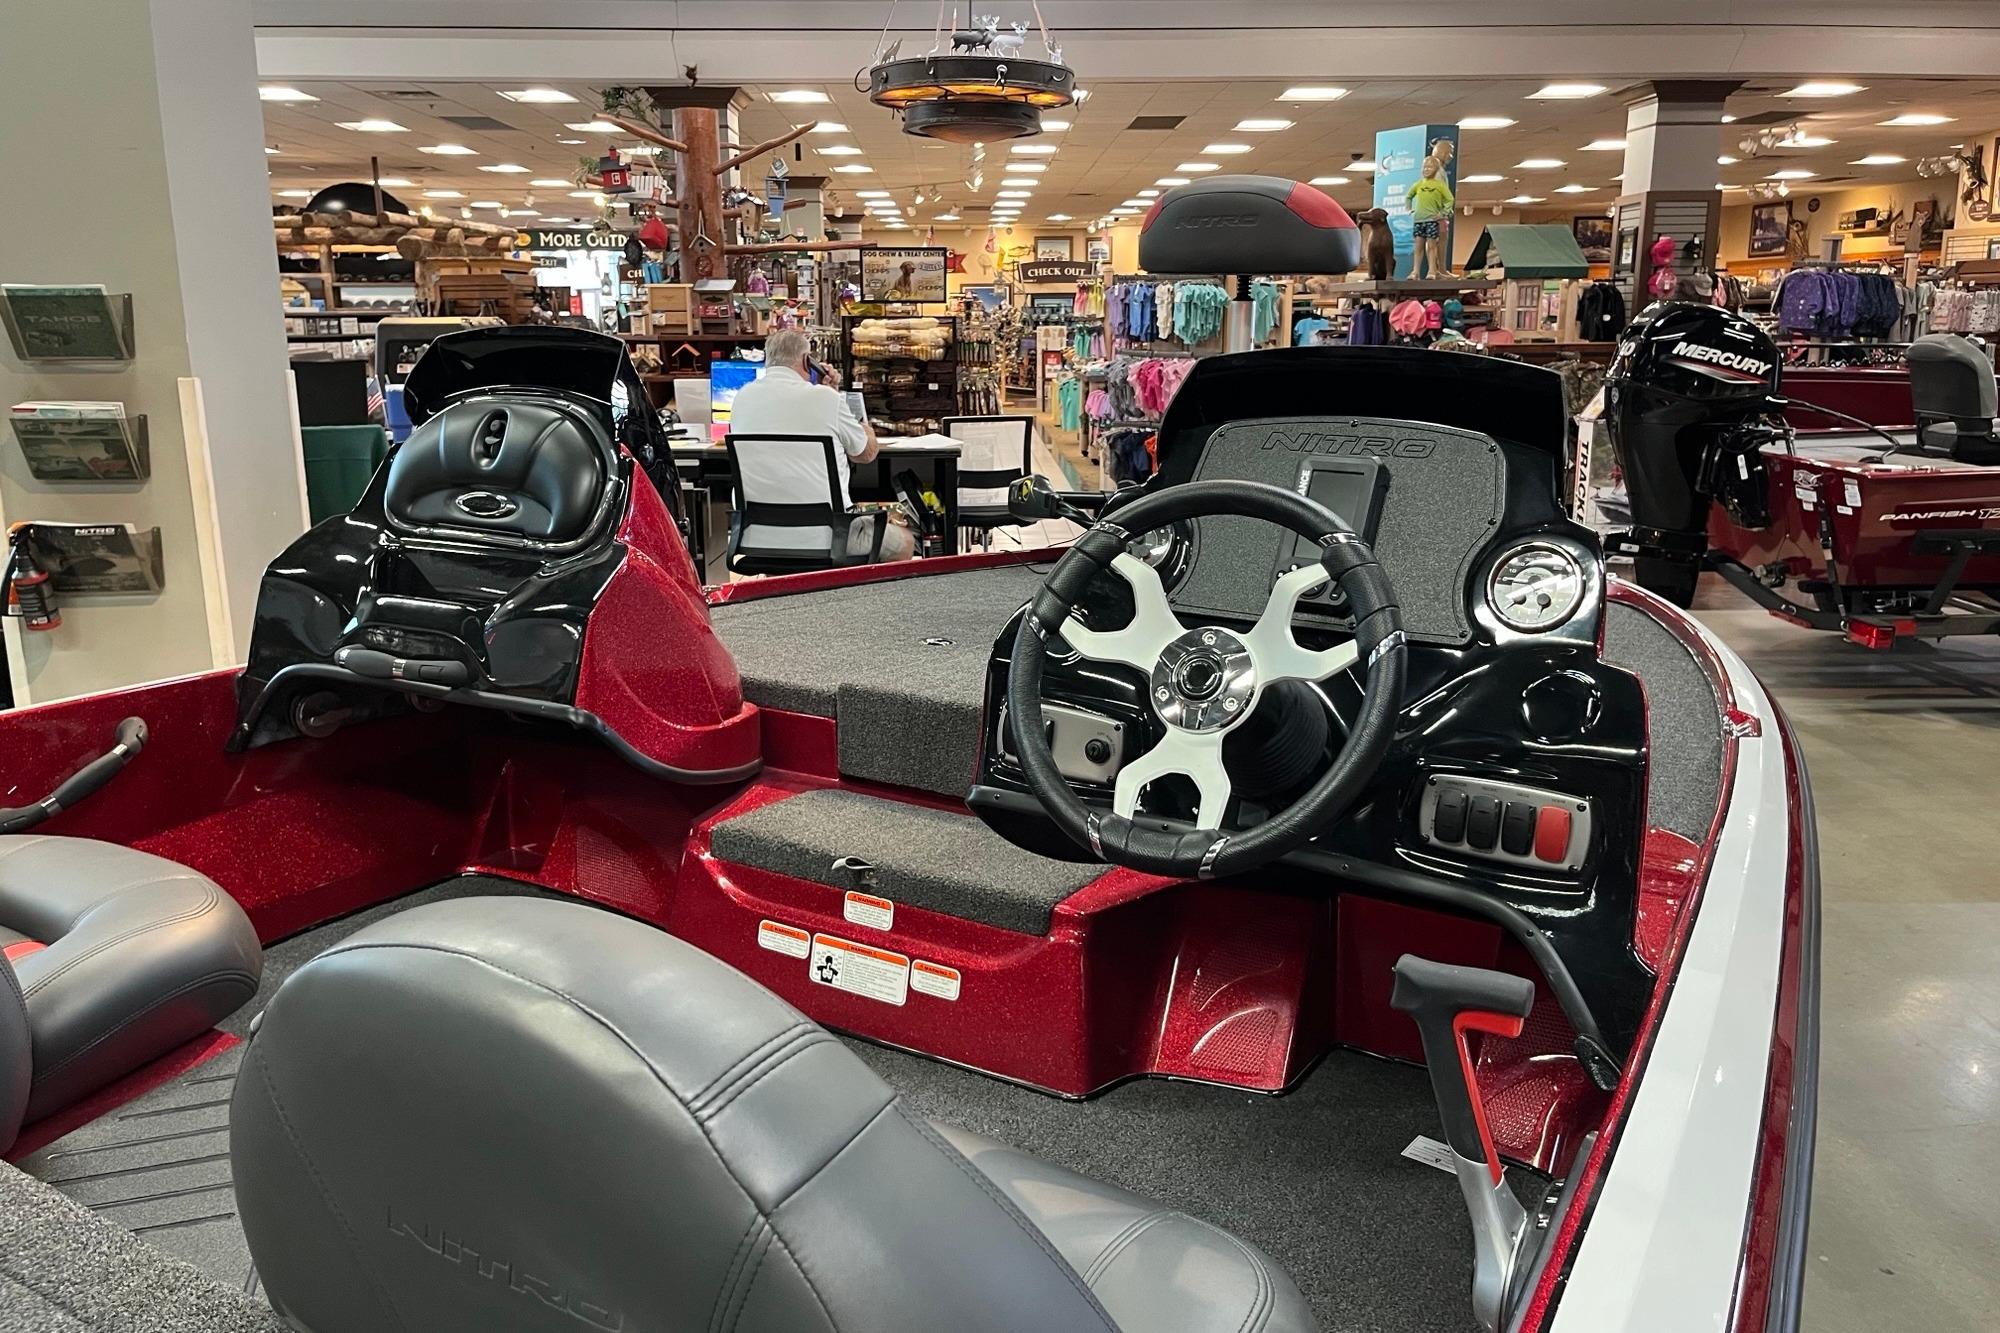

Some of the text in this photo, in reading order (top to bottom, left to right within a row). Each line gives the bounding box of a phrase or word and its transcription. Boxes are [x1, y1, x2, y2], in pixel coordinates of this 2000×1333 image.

[539, 232, 582, 247] MORE
[1027, 267, 1086, 277] CHECK OUT
[1672, 341, 1772, 375] MERCURY
[1261, 431, 1437, 459] NITRO
[1879, 509, 1977, 521] PANFISH
[74, 527, 115, 536] NITRO
